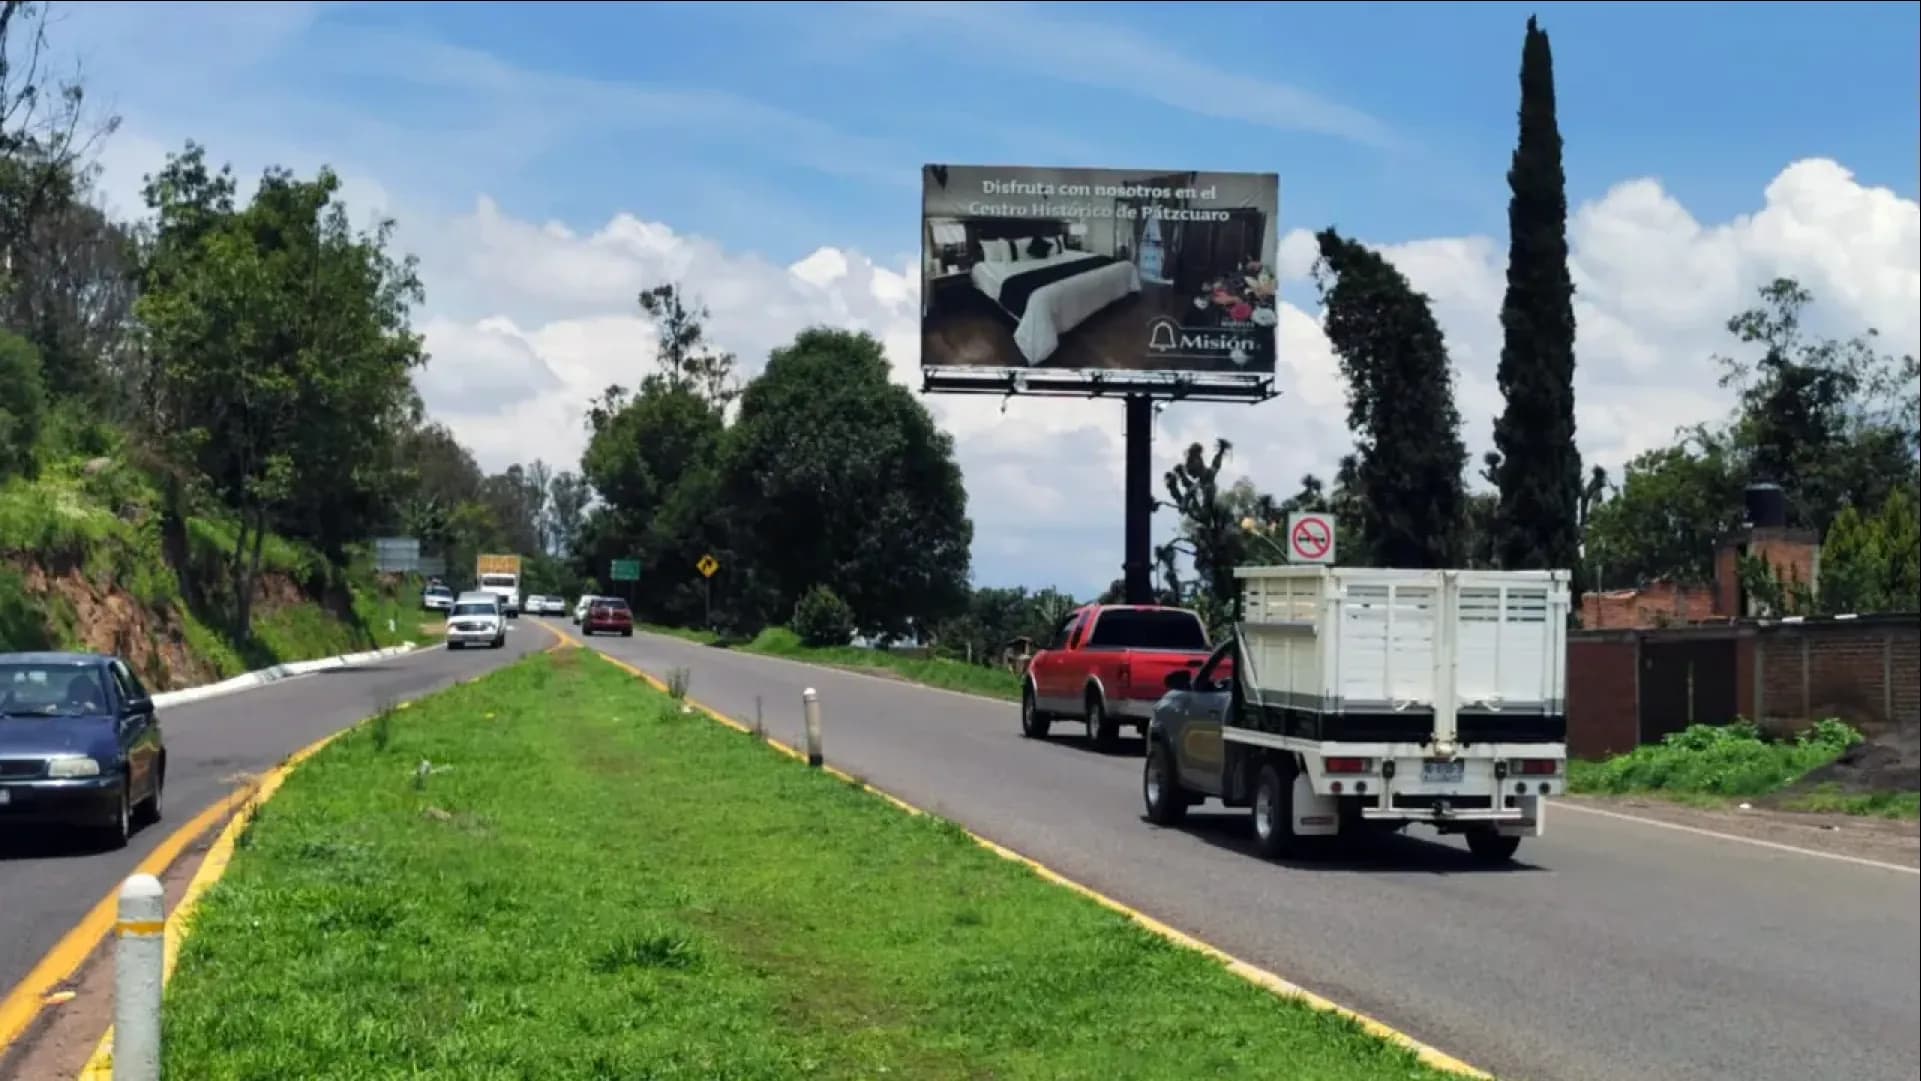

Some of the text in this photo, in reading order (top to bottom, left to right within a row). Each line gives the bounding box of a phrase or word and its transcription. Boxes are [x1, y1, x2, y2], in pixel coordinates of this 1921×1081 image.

[982, 178, 1217, 200] Disfruta con nosotros en el
[968, 201, 1231, 221] Centro Histórico de Pátzcuaro
[1180, 333, 1256, 351] Misión
